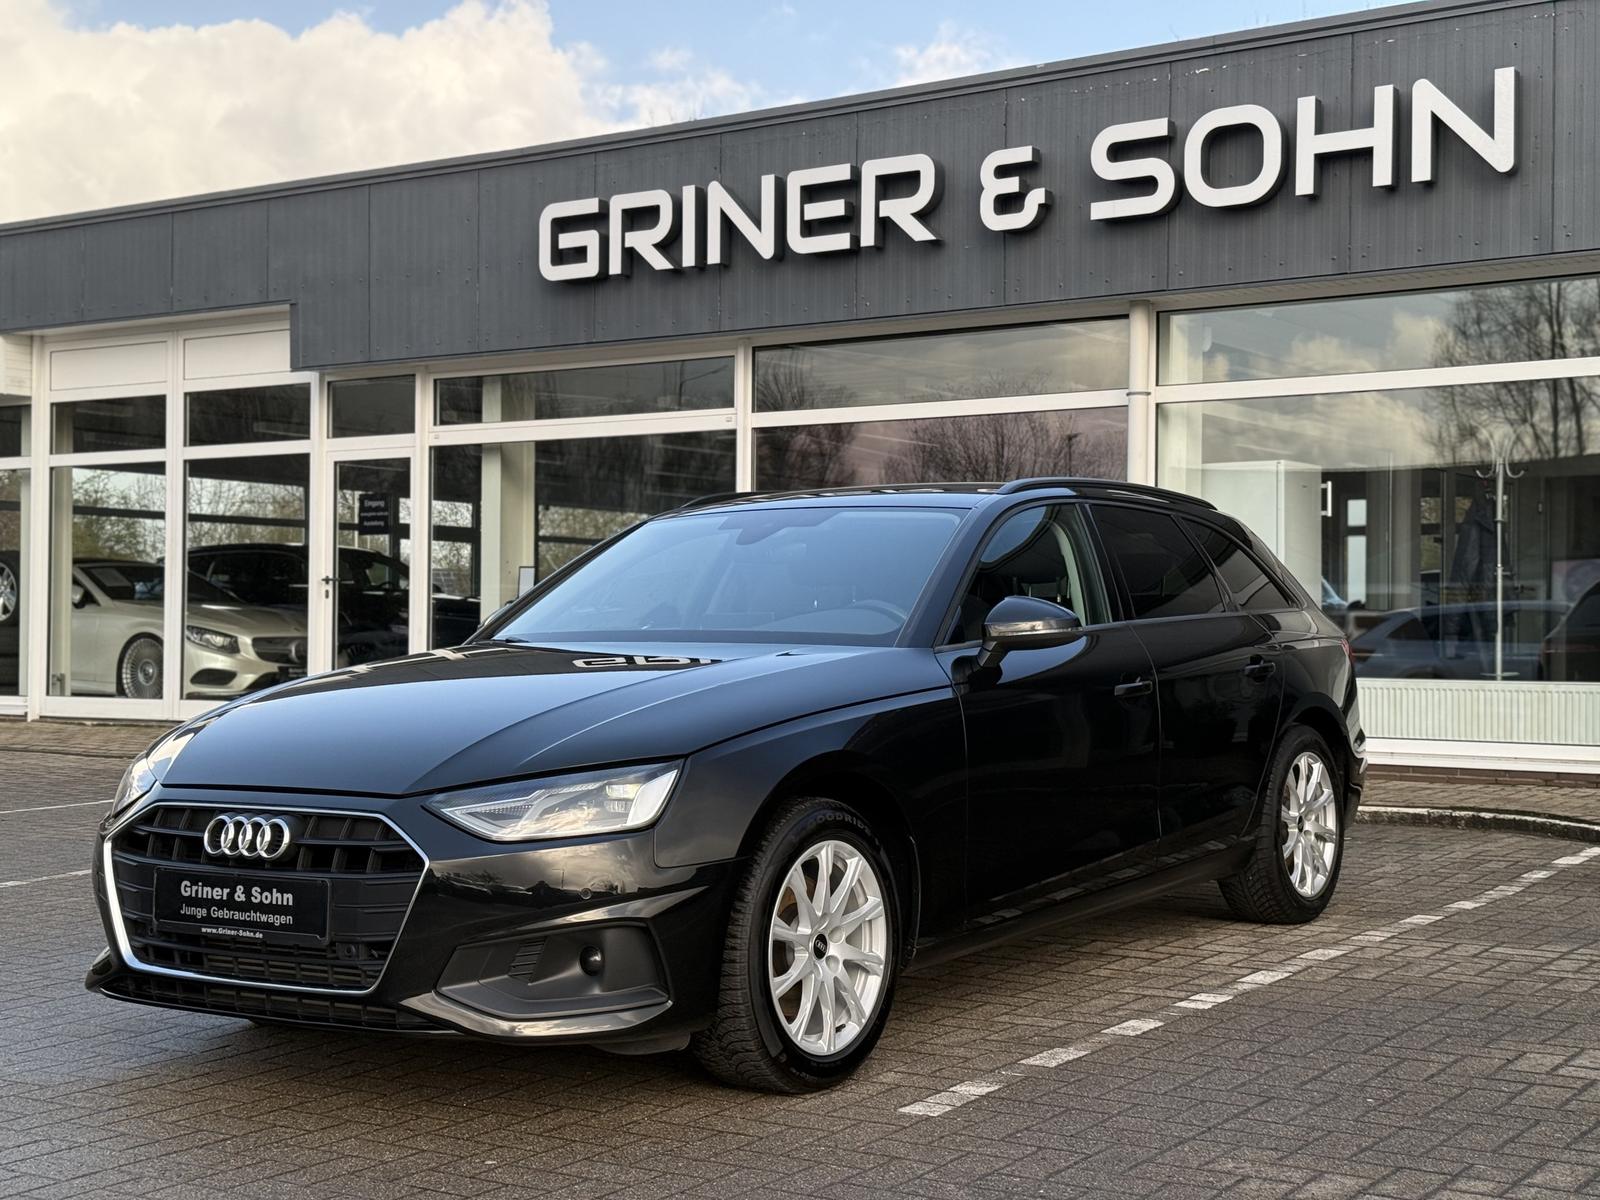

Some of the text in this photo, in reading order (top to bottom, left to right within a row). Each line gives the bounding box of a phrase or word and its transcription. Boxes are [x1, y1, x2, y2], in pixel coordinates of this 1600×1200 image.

[538, 66, 1518, 282] GRINER & SOHN
[180, 880, 294, 906] Griner & Sohn
[180, 903, 294, 926] Junge Gebrauchtwagen
[201, 927, 263, 939] www.Griner-Sohn.de
